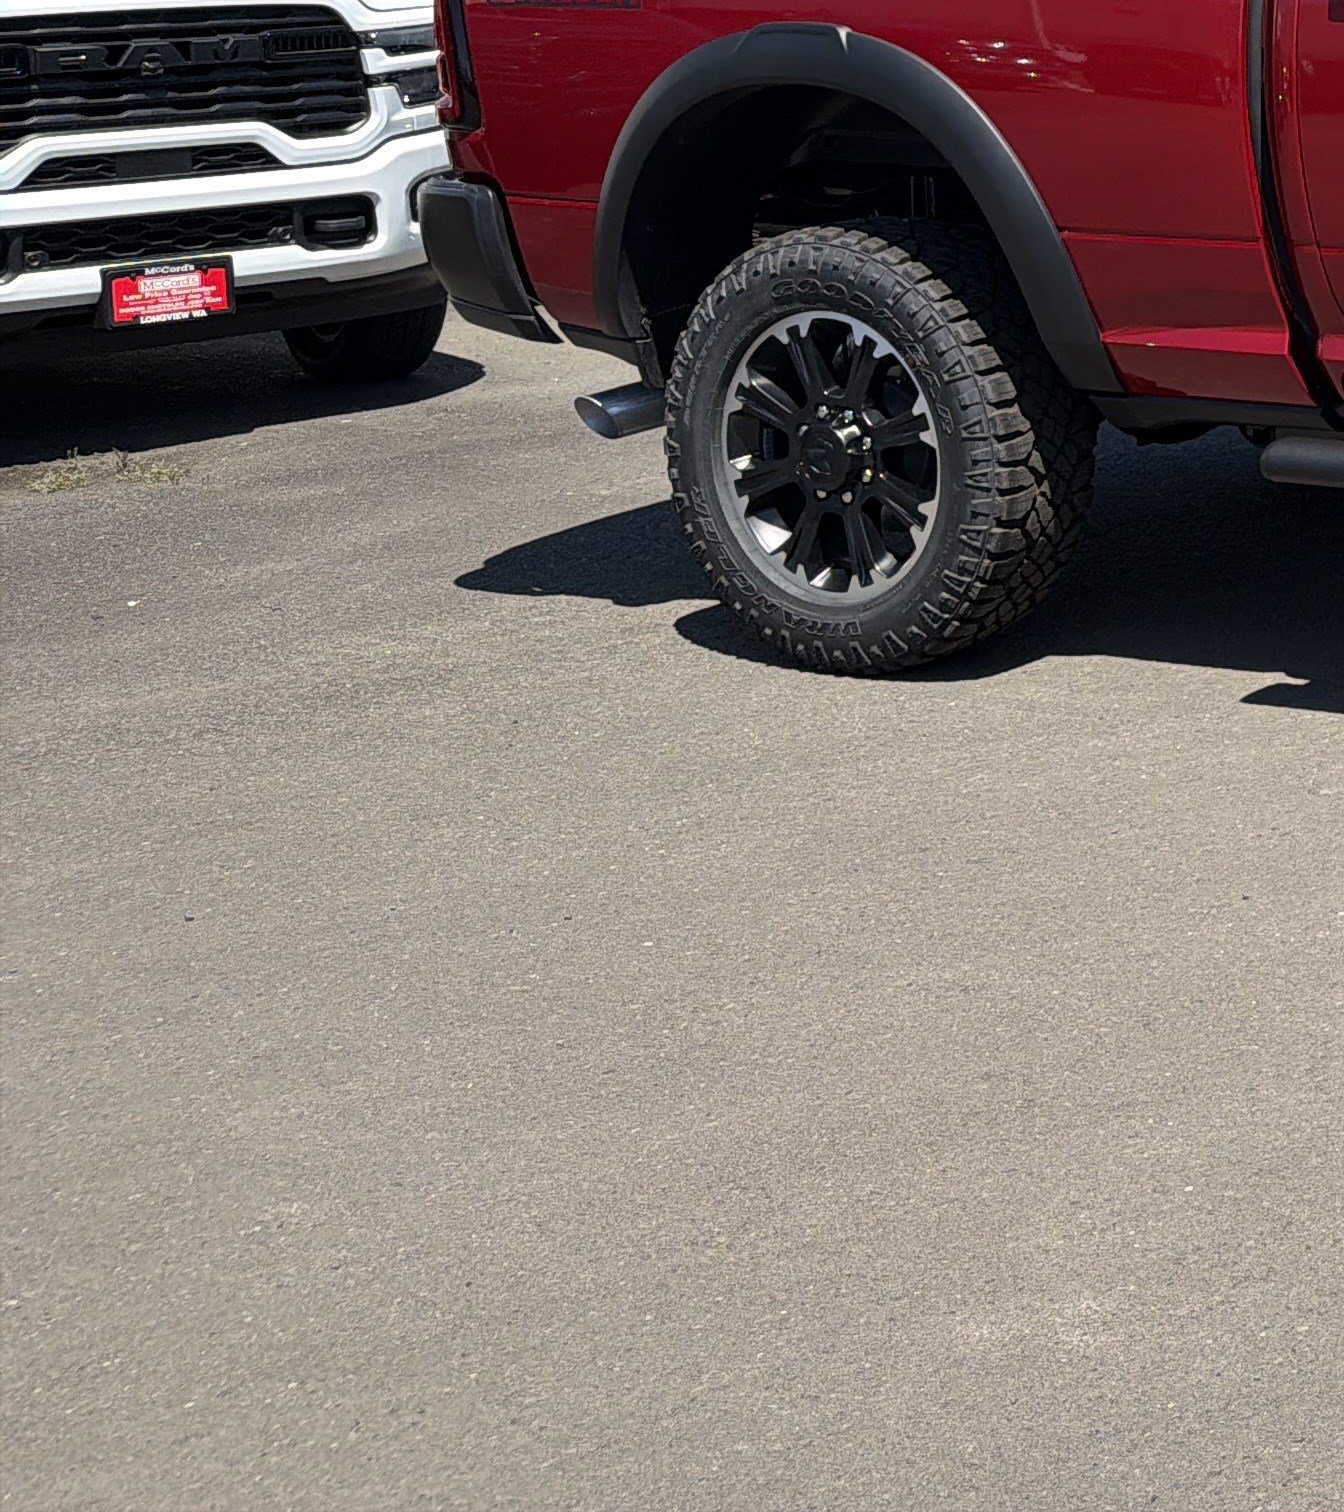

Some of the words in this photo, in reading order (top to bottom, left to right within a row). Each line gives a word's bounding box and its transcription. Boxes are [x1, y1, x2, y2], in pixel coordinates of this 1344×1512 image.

[34, 34, 262, 76] RAM
[140, 311, 190, 325] LONGVIEW
[192, 308, 209, 318] WA
[770, 277, 955, 435] GOODYEAR
[689, 484, 862, 638] WRANGLER
